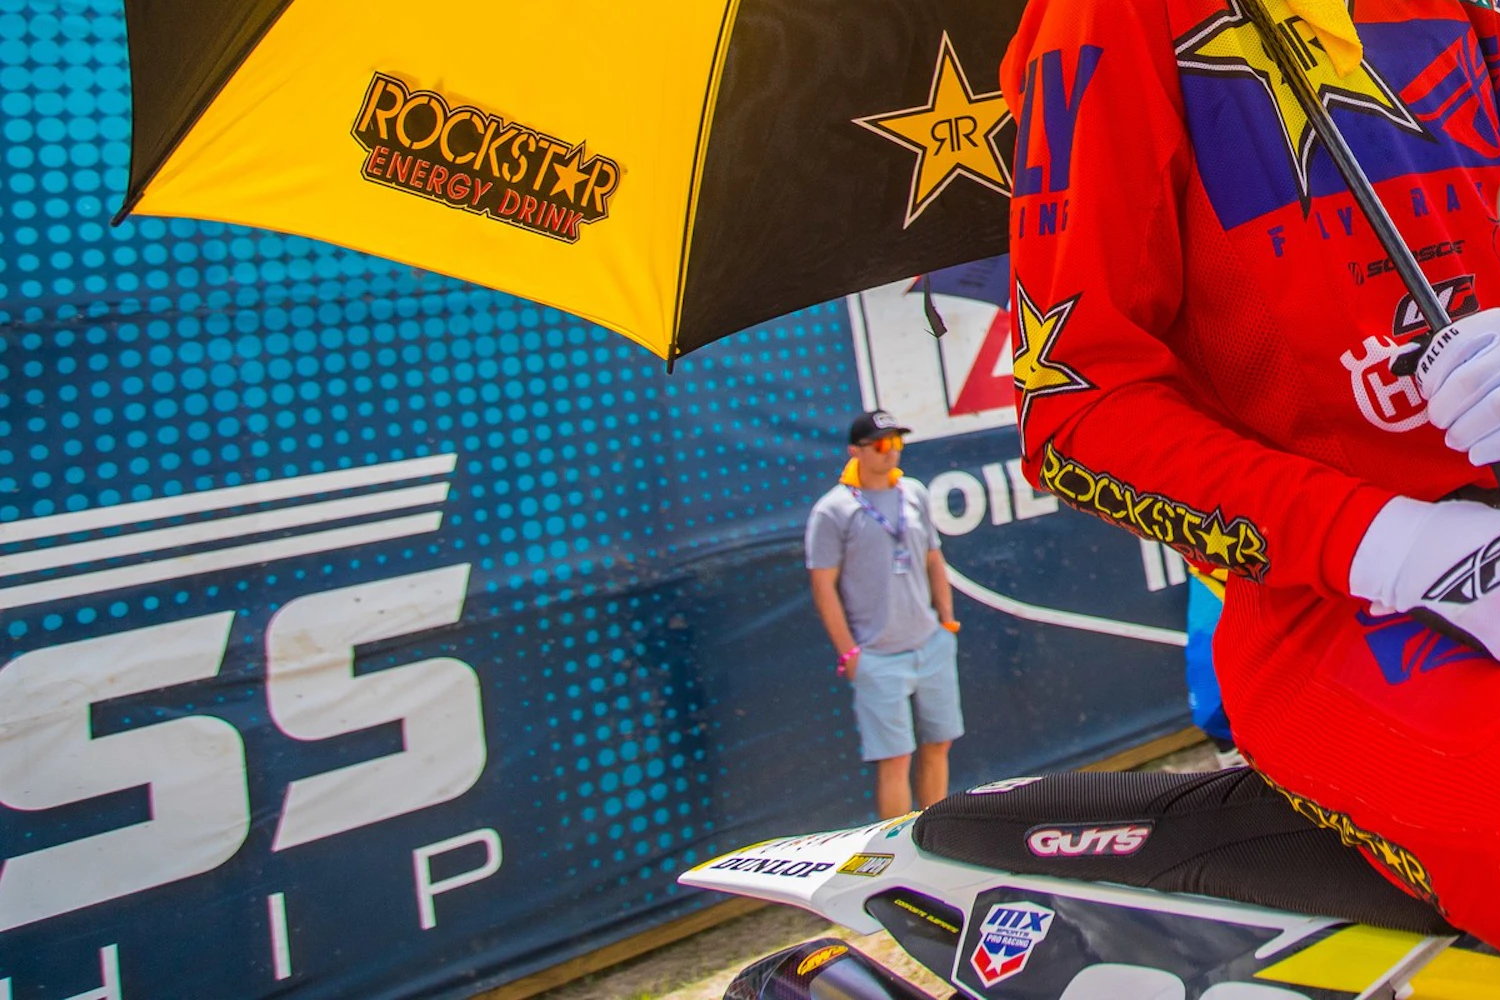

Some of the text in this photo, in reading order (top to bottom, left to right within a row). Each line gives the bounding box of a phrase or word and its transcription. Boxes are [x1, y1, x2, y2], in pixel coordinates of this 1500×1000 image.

[369, 146, 587, 241] ENERGY DRINK
[1420, 325, 1460, 376] RACING
[1028, 826, 1150, 856] GUTS
[711, 857, 836, 879] DUNLOP
[986, 934, 1030, 949] PRO RACING
